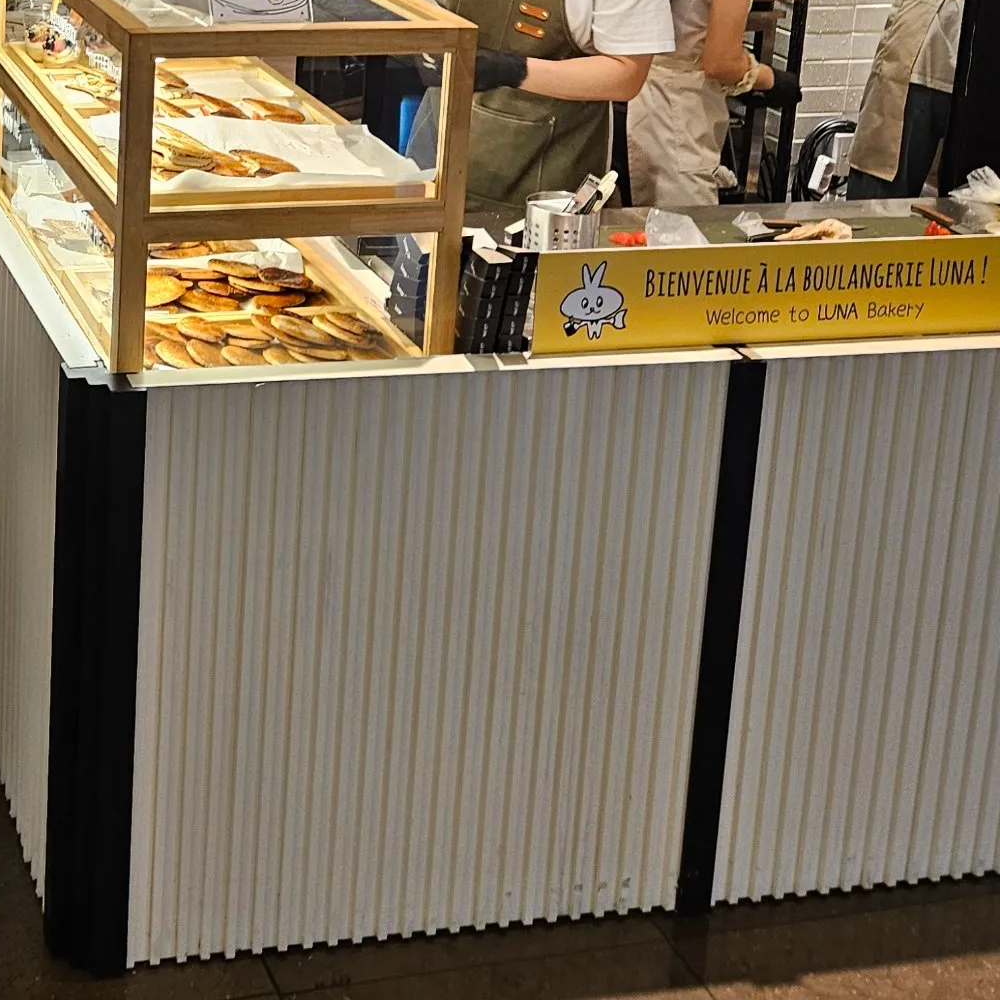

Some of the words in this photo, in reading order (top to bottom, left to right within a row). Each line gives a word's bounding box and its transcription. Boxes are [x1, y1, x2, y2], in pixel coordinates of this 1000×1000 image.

[645, 268, 752, 298] BIENVENUE
[757, 262, 769, 294] À
[774, 269, 796, 293] LA
[803, 261, 925, 292] BOULANGERIE
[705, 308, 781, 327] Welcome
[789, 308, 810, 322] to
[817, 302, 859, 321] LUNA
[867, 300, 925, 320] Bakery
